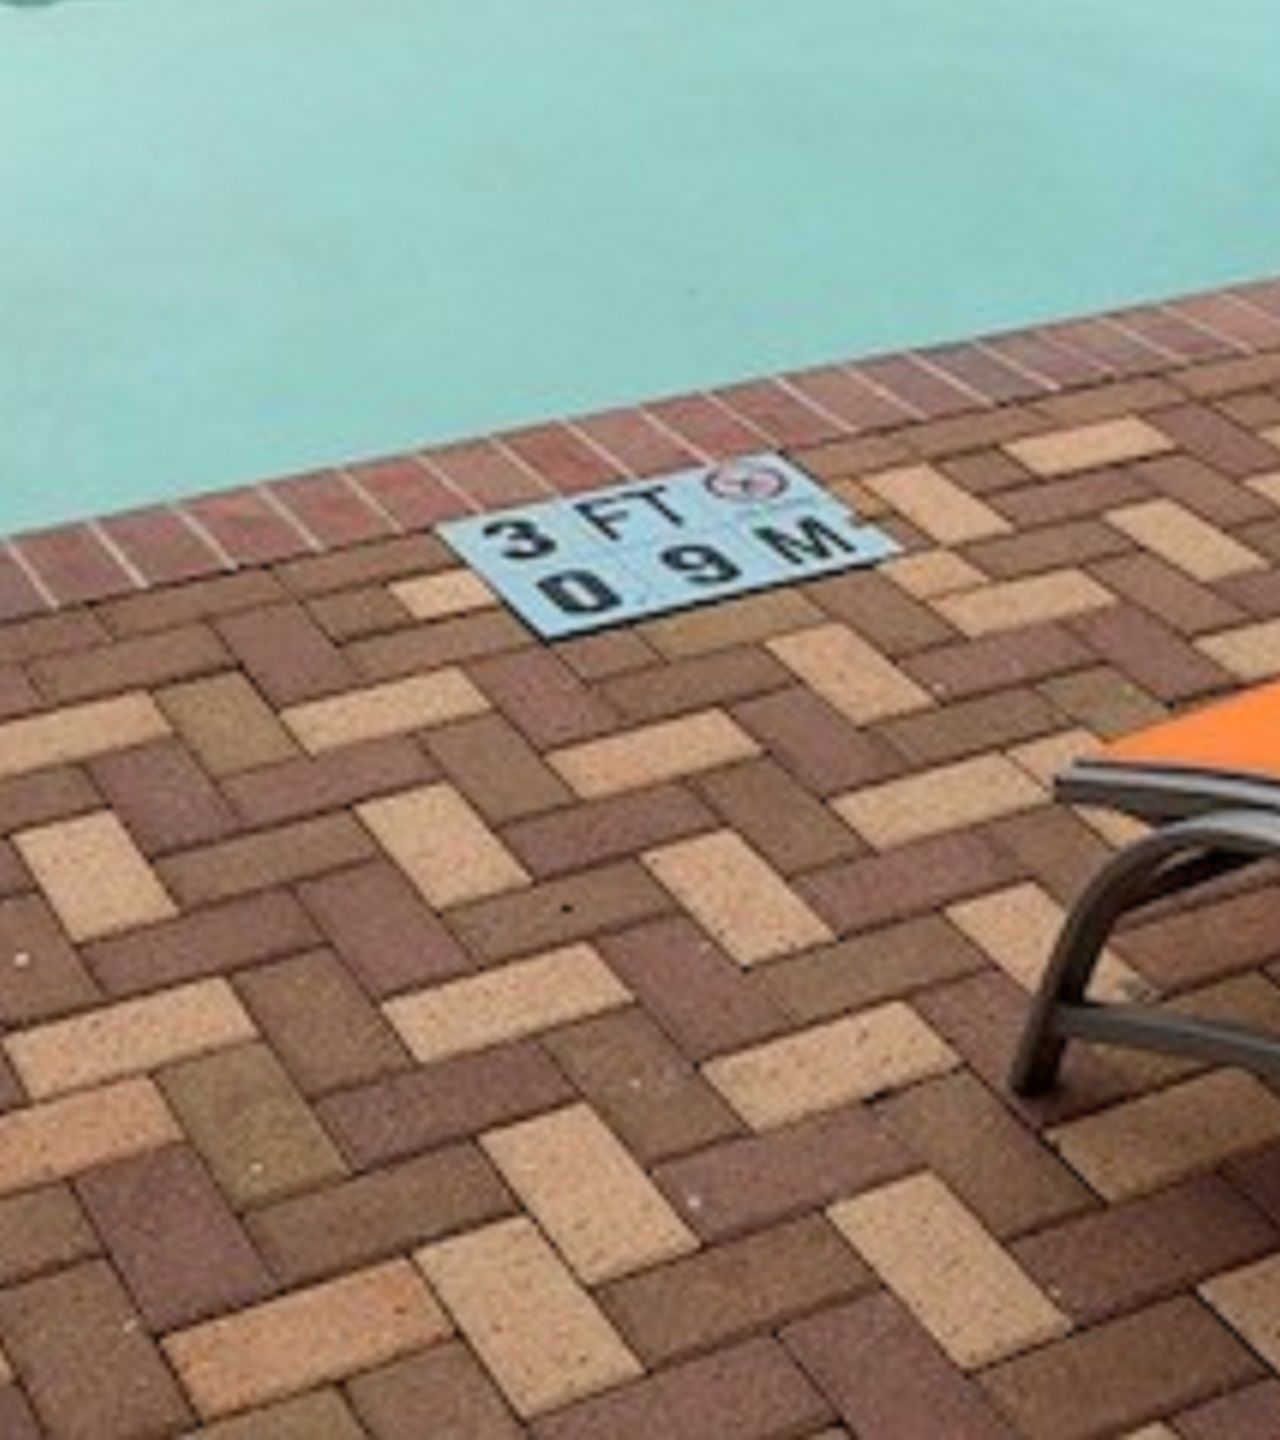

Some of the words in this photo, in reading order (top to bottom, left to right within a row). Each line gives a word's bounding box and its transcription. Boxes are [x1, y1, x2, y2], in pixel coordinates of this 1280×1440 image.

[483, 519, 558, 559] 3
[573, 486, 686, 542] FT
[753, 515, 856, 565] M
